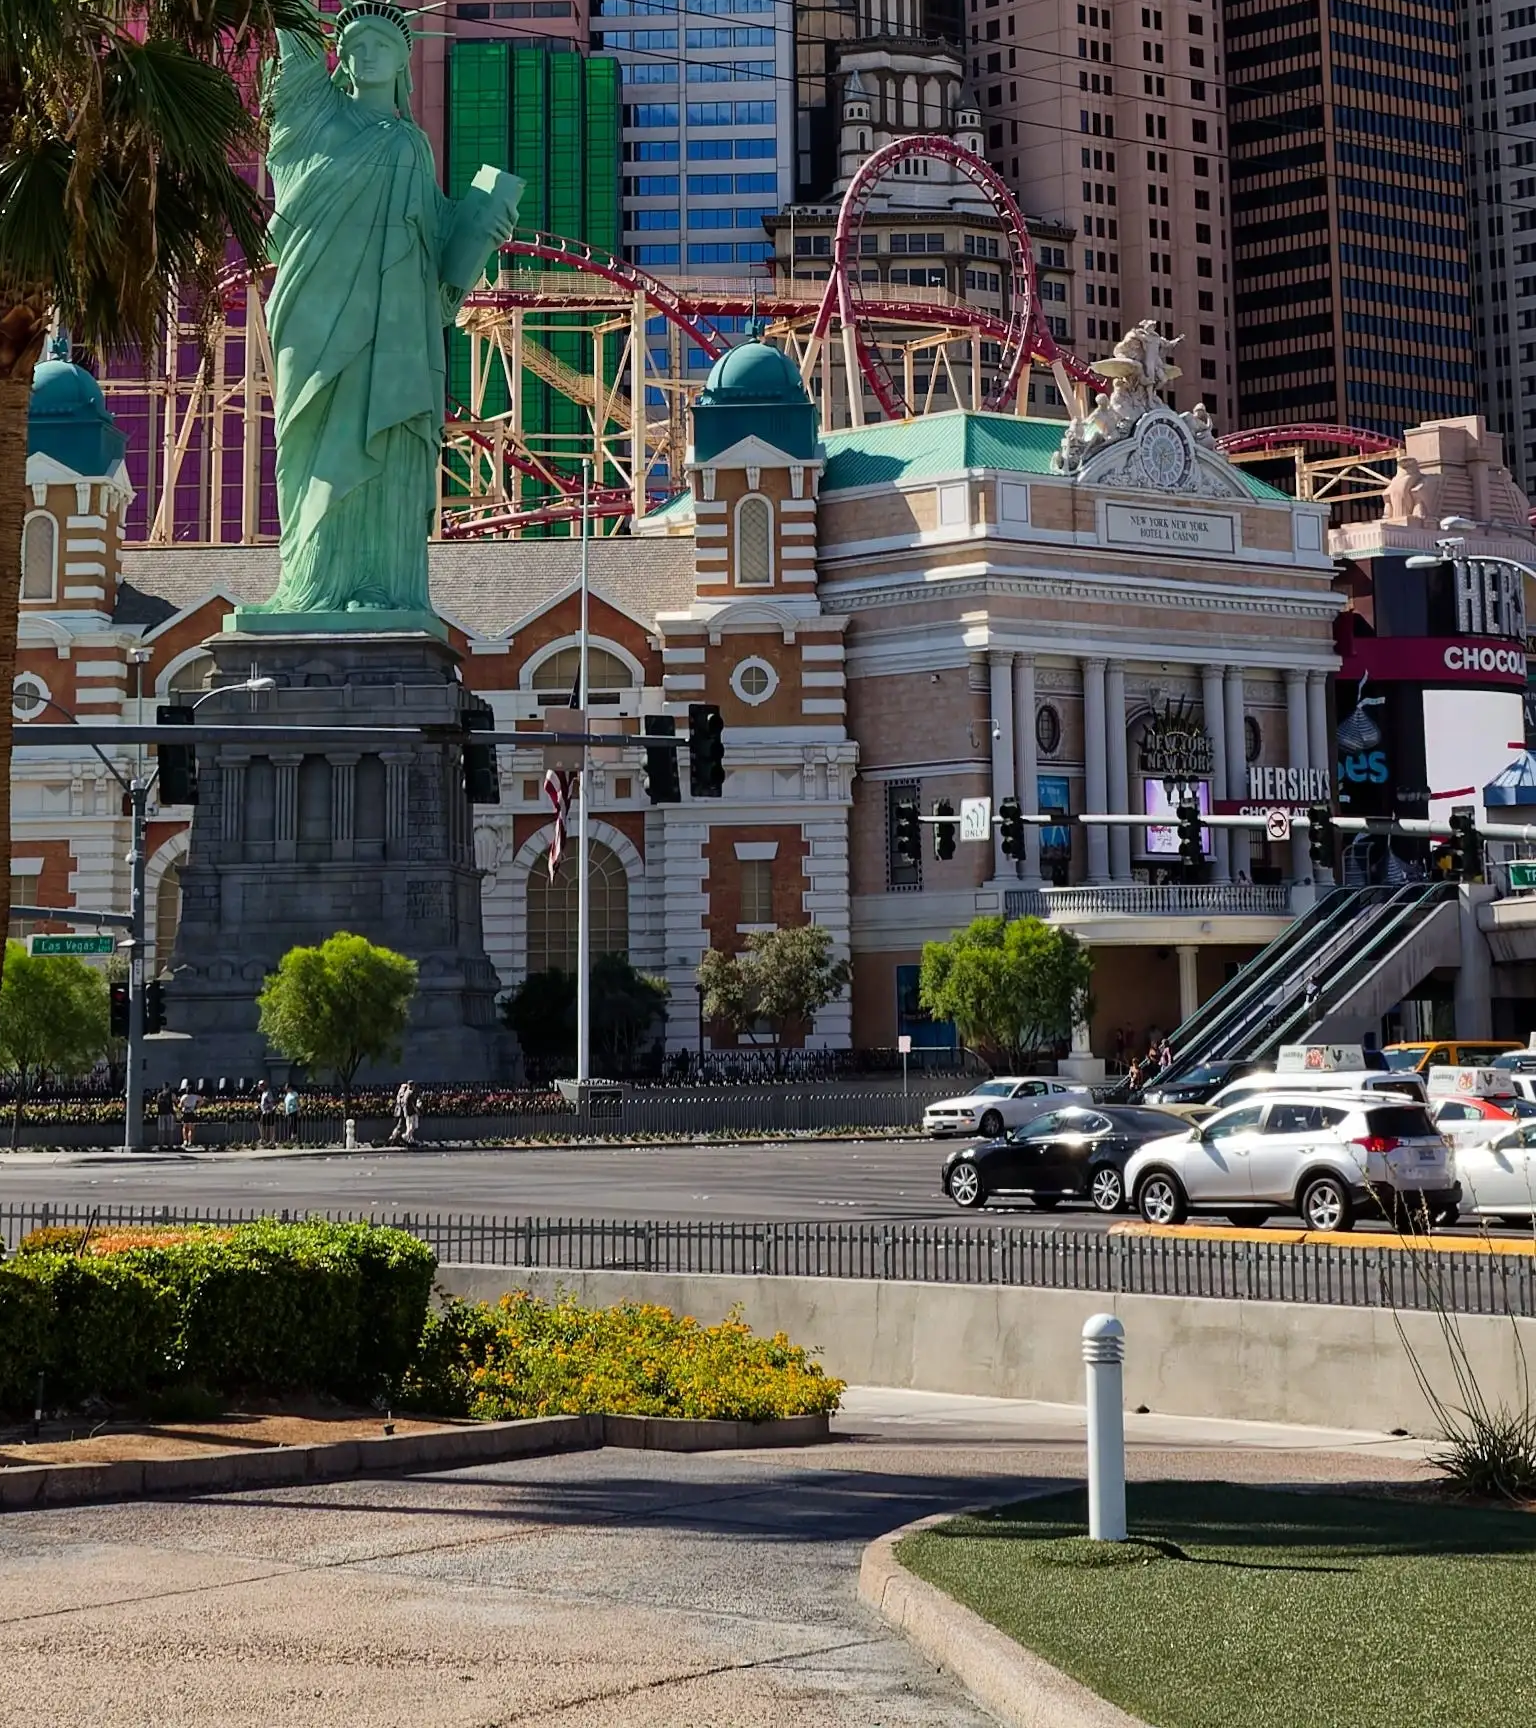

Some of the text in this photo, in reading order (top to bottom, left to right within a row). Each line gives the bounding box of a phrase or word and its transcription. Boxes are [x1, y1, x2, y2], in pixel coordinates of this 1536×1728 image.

[1130, 515, 1209, 532] NEW YORK NEW YORK
[1140, 527, 1162, 539] HOTEL
[1172, 531, 1199, 543] CASINO
[964, 829, 984, 838] ONLY
[41, 940, 61, 951] Las
[66, 940, 95, 952] Vegas
